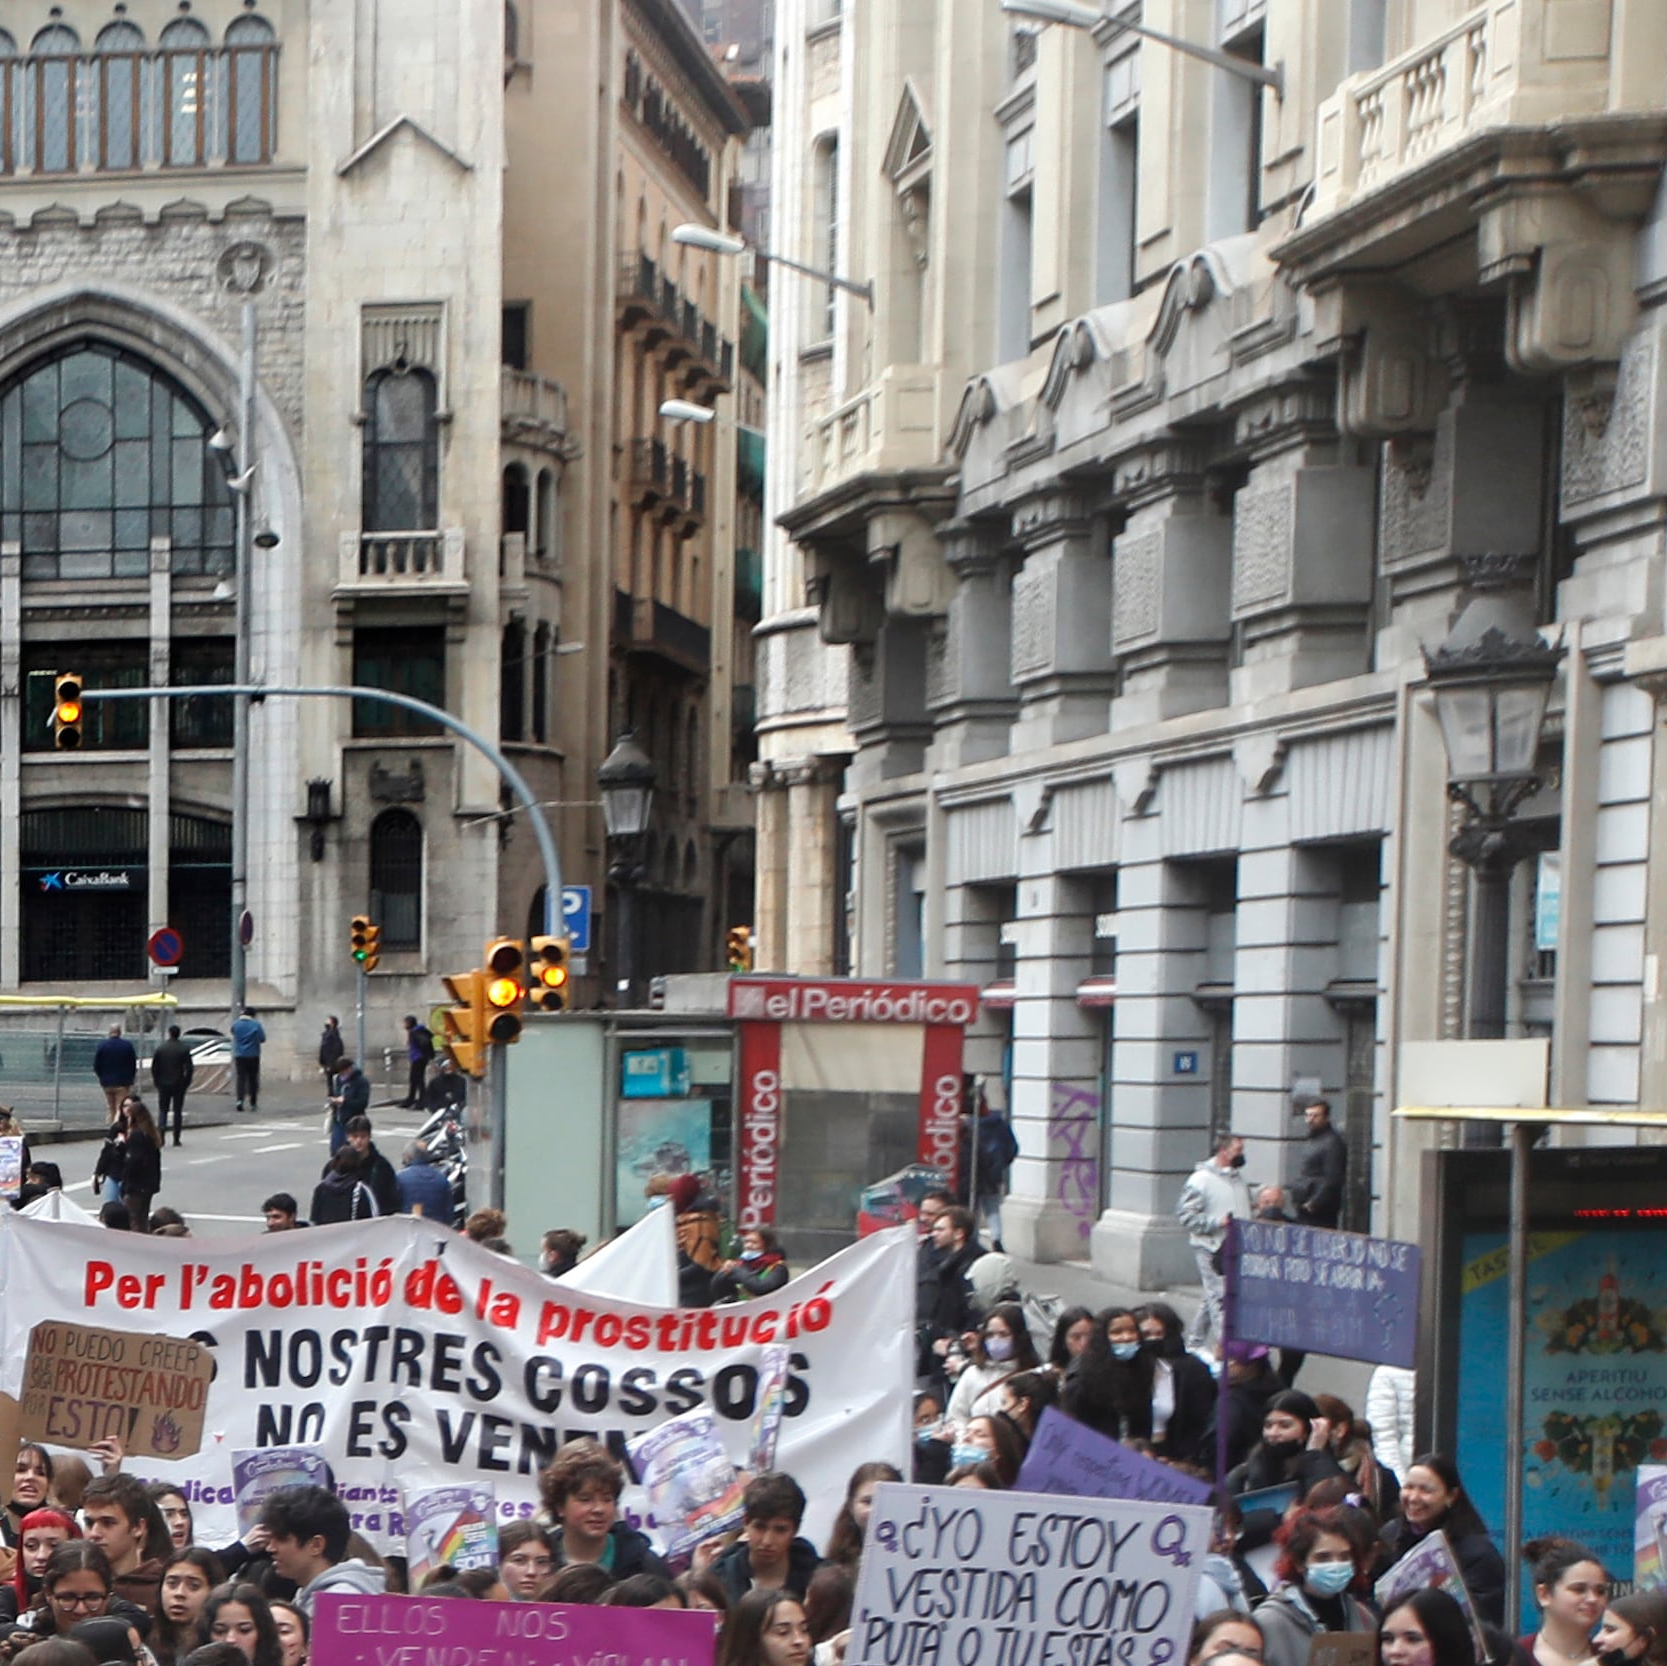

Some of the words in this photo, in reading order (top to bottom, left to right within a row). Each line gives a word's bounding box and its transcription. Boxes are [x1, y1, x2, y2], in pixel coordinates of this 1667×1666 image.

[64, 870, 130, 889] CaixaBank
[805, 986, 970, 1024] Periódico
[84, 1260, 167, 1310] Per
[404, 1258, 463, 1316] de
[475, 1277, 521, 1329] la
[536, 1281, 833, 1353] prostitució
[32, 1328, 58, 1354] NO
[66, 1332, 126, 1362] PUEDO
[139, 1340, 200, 1371] CREER
[244, 1324, 503, 1404] NOSTRES
[524, 1350, 812, 1421] COSSOS
[54, 1359, 207, 1411] PROTESTANDO
[1531, 1387, 1587, 1402] SENSE
[1566, 1369, 1649, 1384] APERITIU
[346, 1401, 411, 1461] ES
[1008, 1512, 1142, 1573] ESTOY
[336, 1604, 448, 1636] ELLOS
[496, 1610, 571, 1641] NOS
[886, 1567, 1037, 1624] VESTIDA
[1054, 1573, 1173, 1635] COMO
